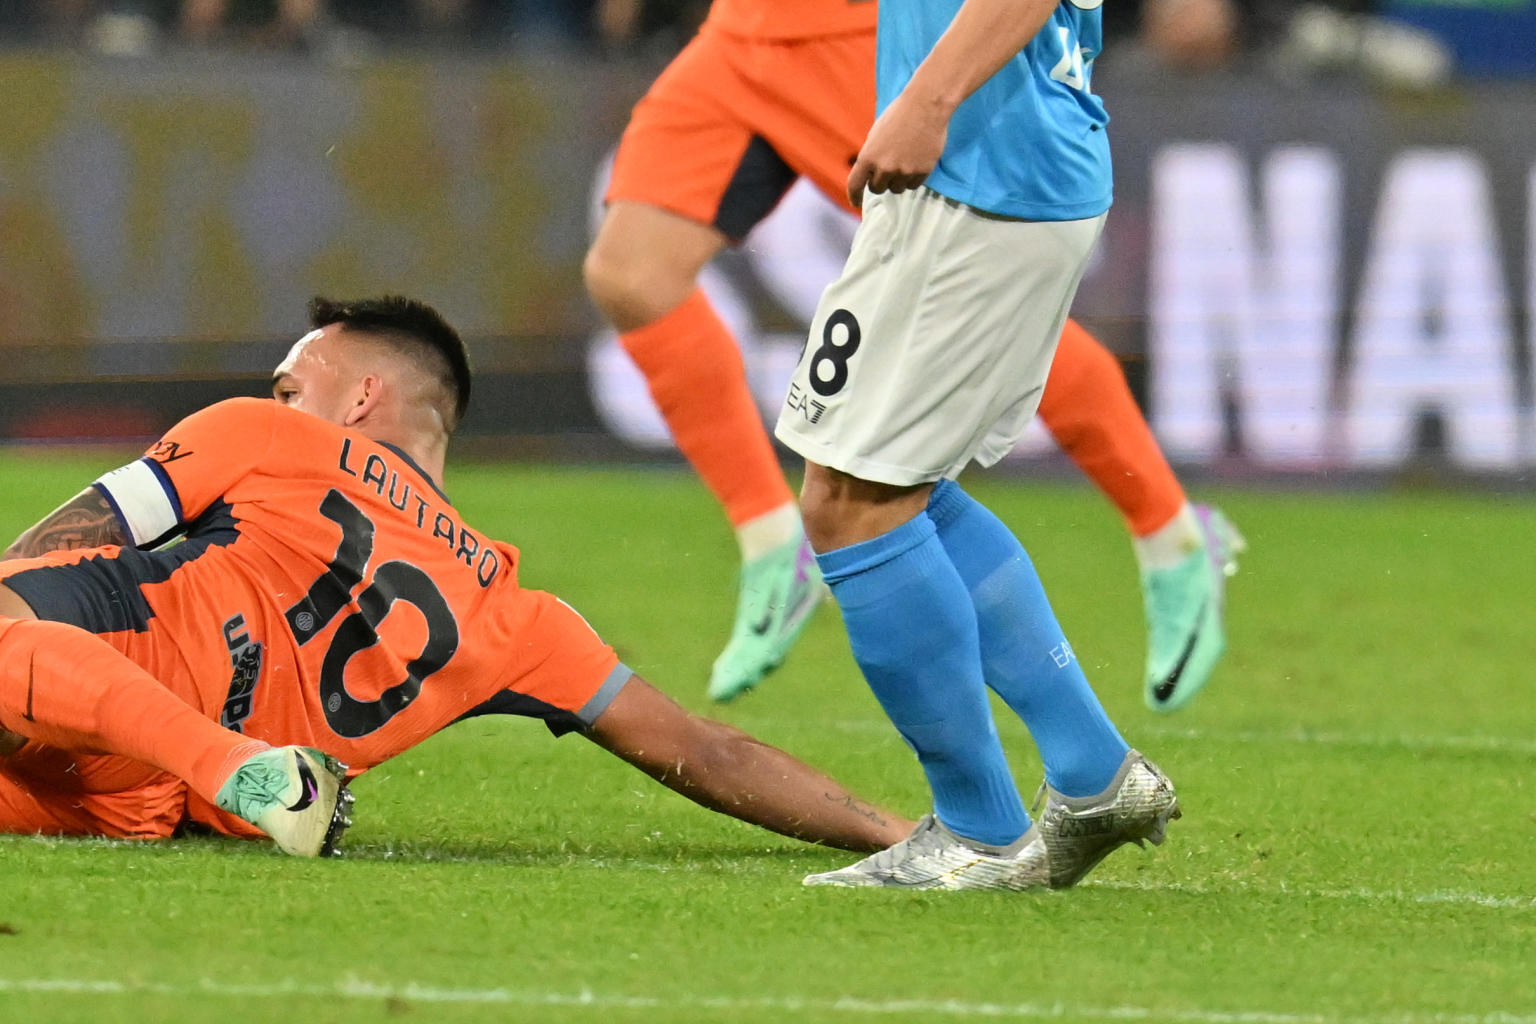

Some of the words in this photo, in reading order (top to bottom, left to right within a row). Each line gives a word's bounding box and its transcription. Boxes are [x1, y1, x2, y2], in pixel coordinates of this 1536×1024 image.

[798, 308, 861, 397] 8
[1149, 142, 1536, 466] NA
[787, 382, 827, 424] EA7
[338, 437, 499, 588] LAUTARO
[284, 488, 460, 739] 10
